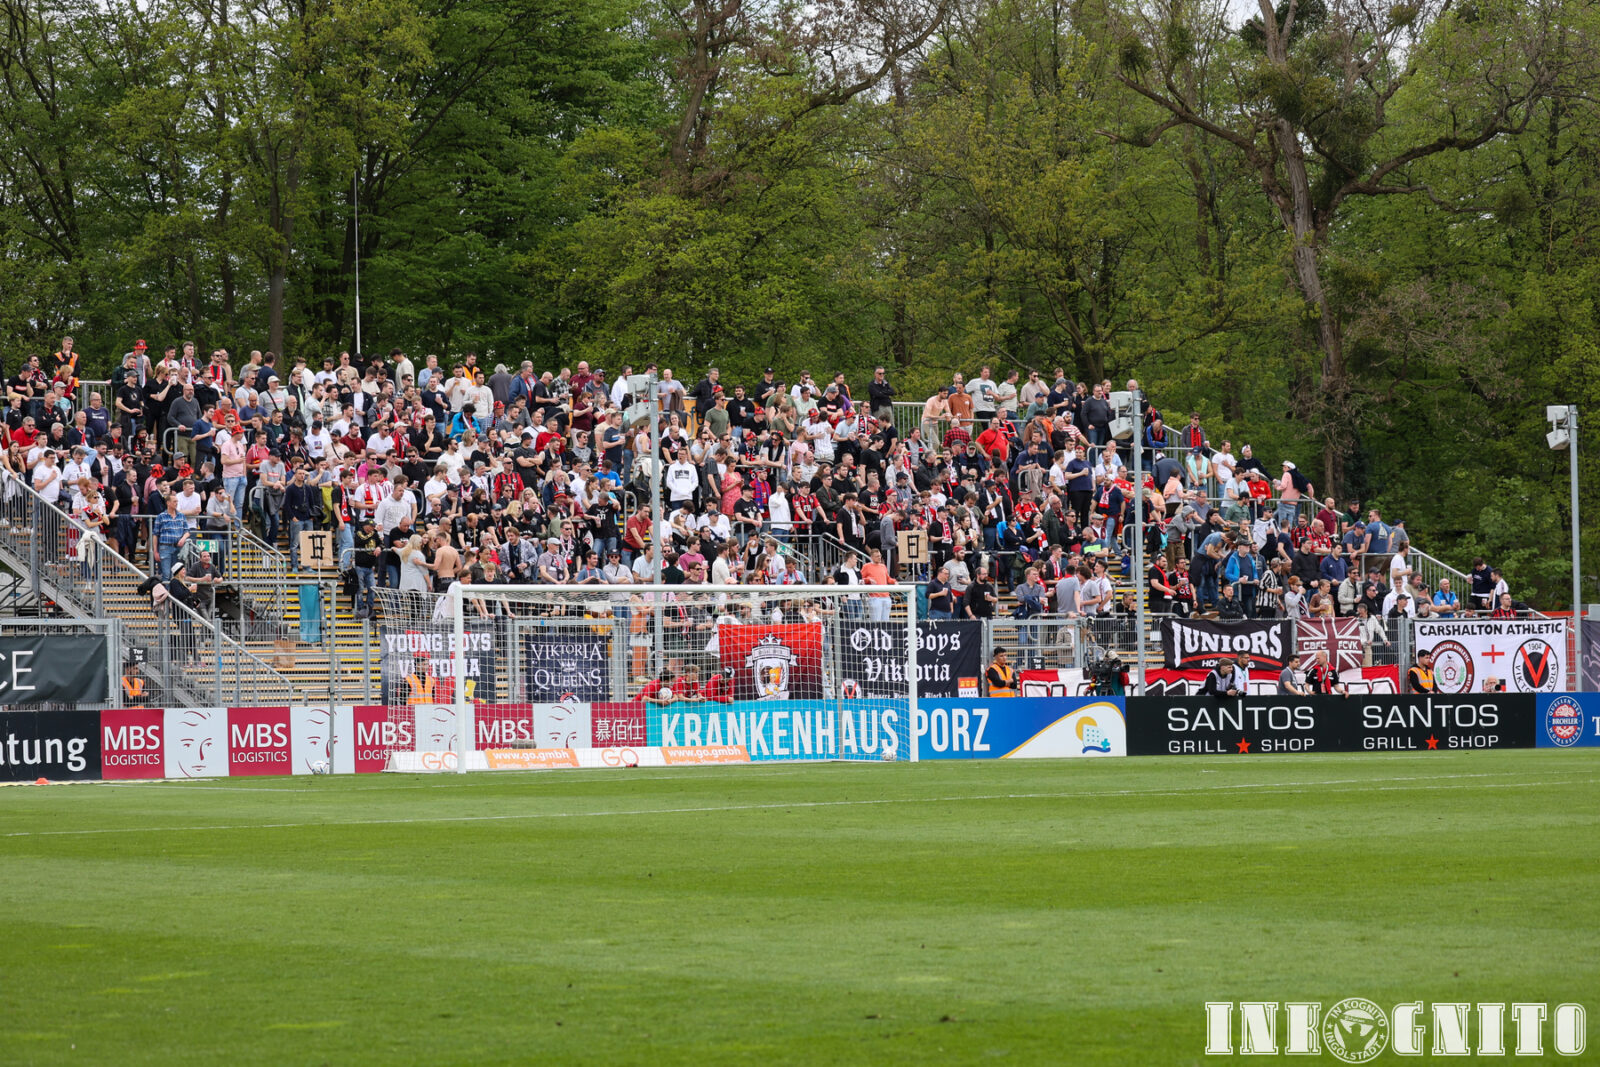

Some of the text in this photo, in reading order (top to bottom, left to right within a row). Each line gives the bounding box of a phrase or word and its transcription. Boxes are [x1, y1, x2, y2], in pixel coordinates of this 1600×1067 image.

[850, 627, 892, 652] Old
[1419, 622, 1562, 636] CARSHALTON ATHLETIC
[385, 634, 443, 652] YOUNG
[530, 643, 603, 661] VIKTORIA
[1171, 620, 1282, 668] JUNIORS
[0, 650, 36, 690] E
[534, 668, 602, 690] QUEENS
[1168, 700, 1315, 731] SANTOS
[1362, 698, 1499, 728] SANTOS
[104, 725, 160, 750] MBS
[231, 723, 288, 748] MBS
[357, 721, 412, 746] MBS
[478, 719, 531, 743] MBS
[595, 719, 643, 742] 慕佰仕
[661, 710, 898, 756] KRANKENHAUS
[917, 708, 991, 751] PORZ
[667, 746, 742, 758] www.go.gmbh
[1168, 739, 1316, 753] GRILL SHOP
[1363, 735, 1499, 749] GRILL SHOP
[105, 754, 160, 766] LOGISTICS
[232, 751, 288, 763] LOGISTICS
[492, 750, 570, 761] www.go.gmbh
